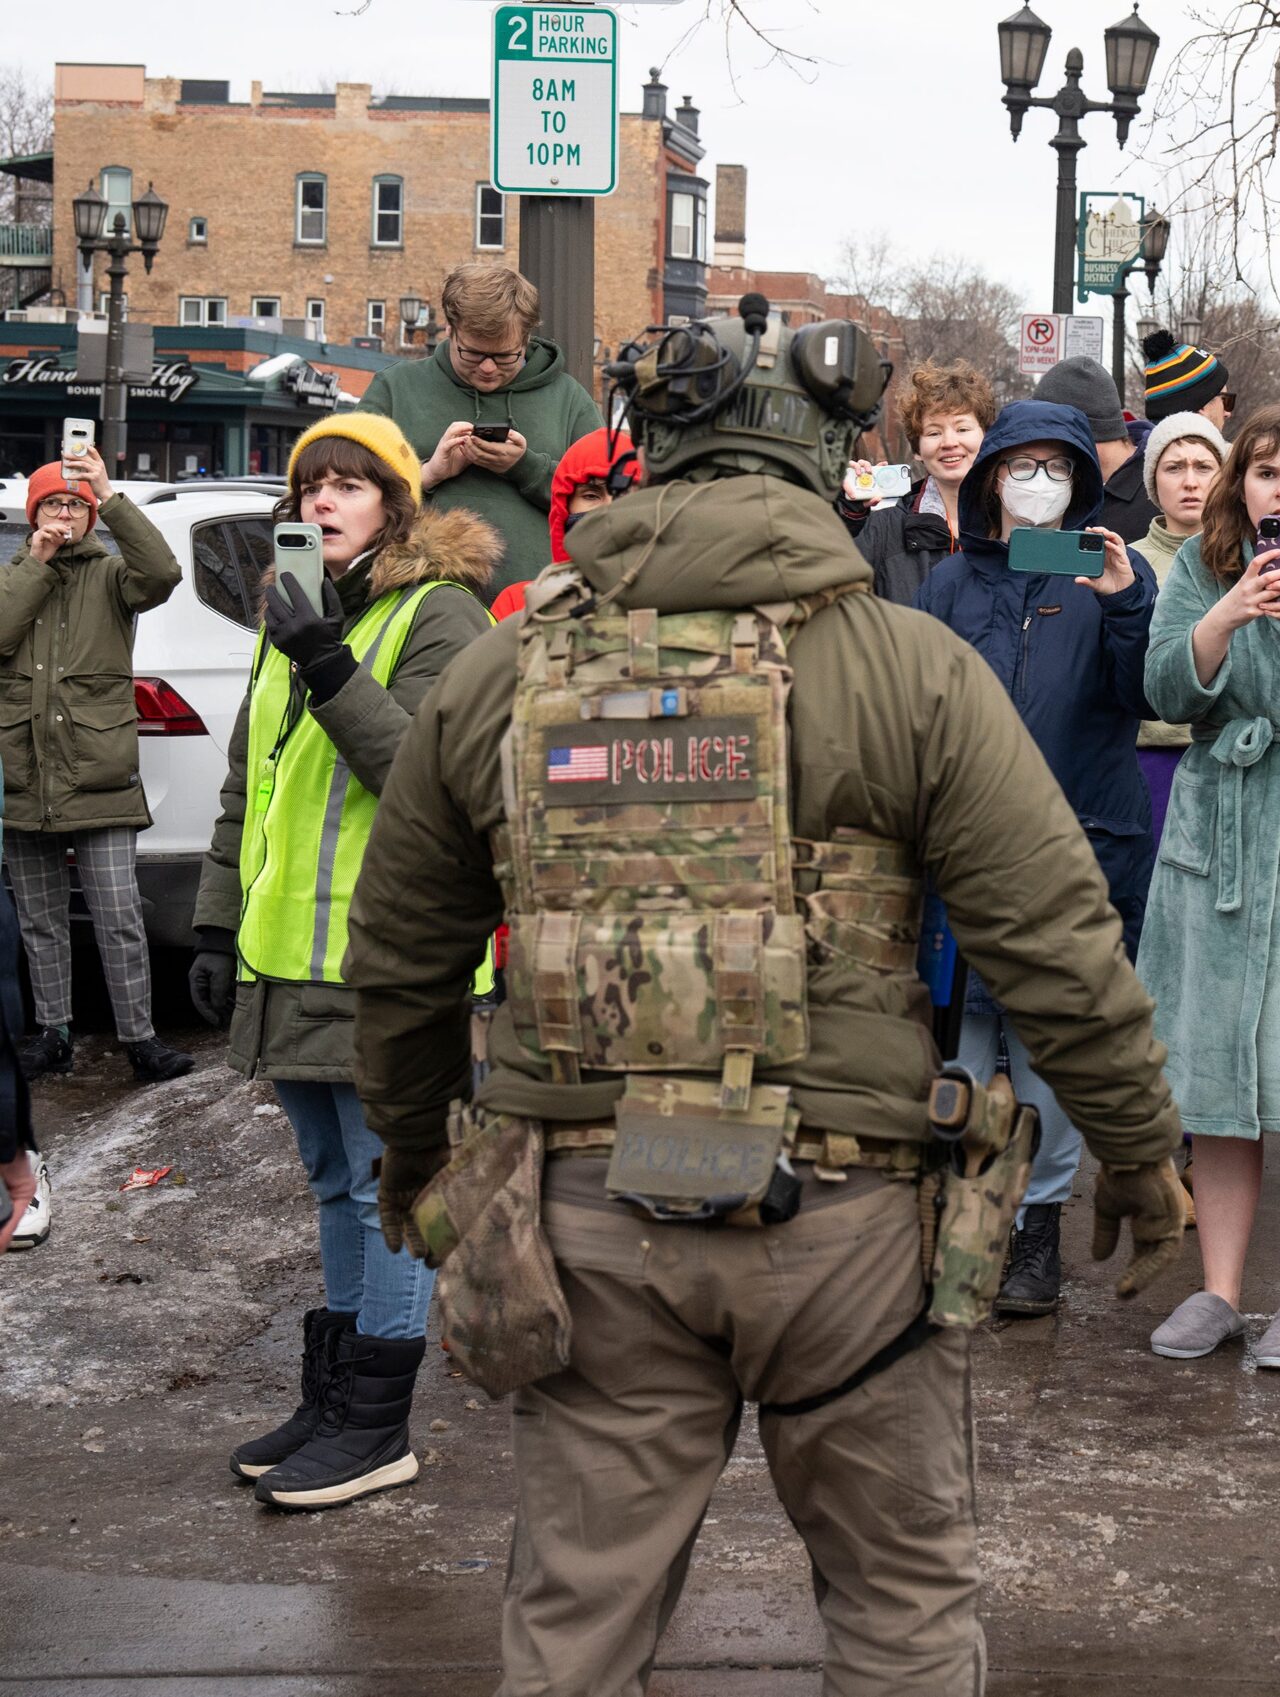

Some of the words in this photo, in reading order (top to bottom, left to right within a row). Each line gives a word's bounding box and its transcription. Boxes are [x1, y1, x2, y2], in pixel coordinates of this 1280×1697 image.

[508, 16, 527, 50] 2
[539, 15, 584, 32] HOUR
[539, 36, 608, 54] PARKING
[532, 78, 576, 101] 8AM
[541, 111, 566, 133] TO
[527, 143, 580, 166] 10PM
[1084, 263, 1118, 273] BUSINESS
[1084, 273, 1115, 282] DISTRICT
[130, 387, 167, 398] SMOKE
[612, 735, 750, 785] POLICE
[619, 1133, 766, 1181] POLICE
